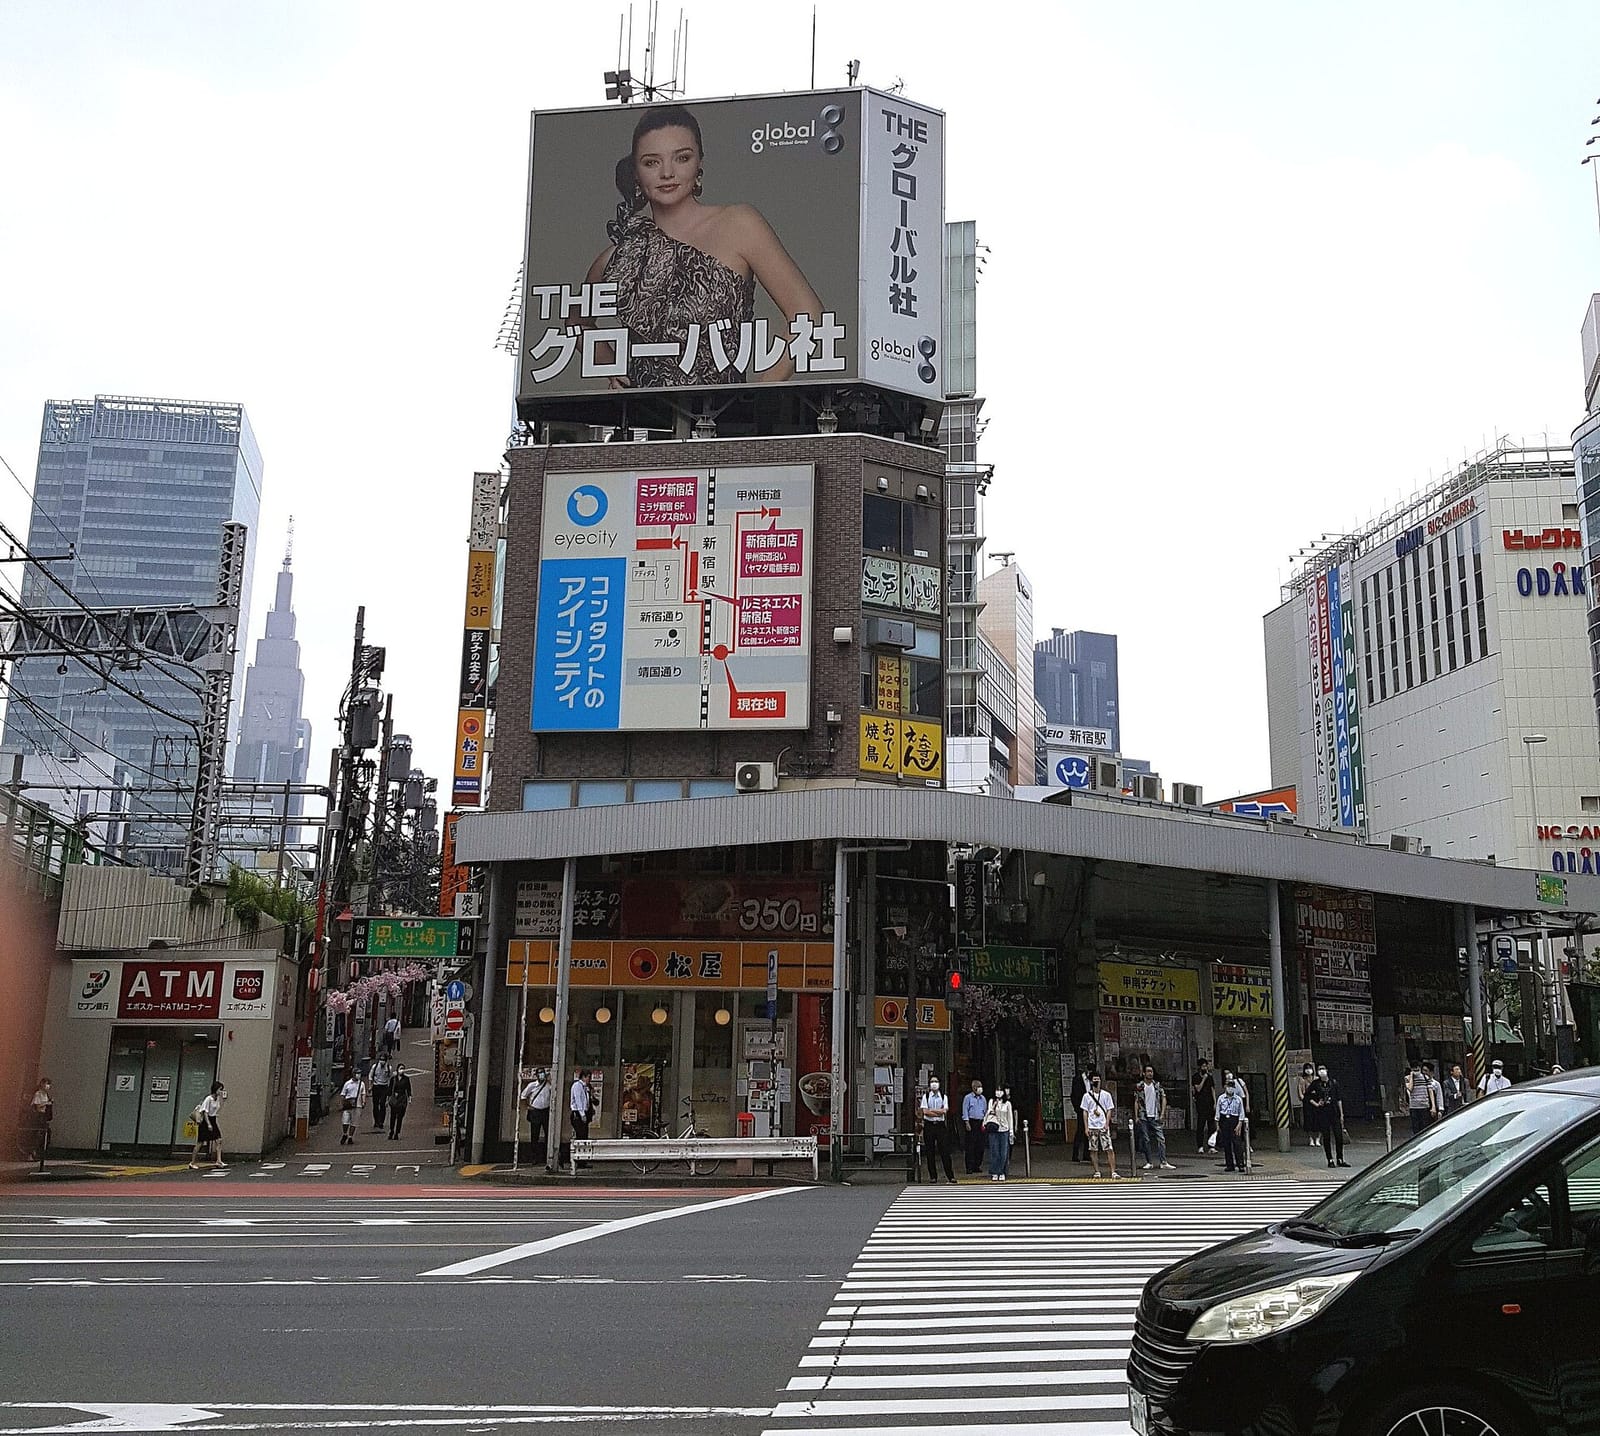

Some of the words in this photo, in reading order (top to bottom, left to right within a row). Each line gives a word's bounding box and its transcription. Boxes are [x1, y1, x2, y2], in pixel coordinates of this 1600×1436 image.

[751, 119, 816, 153] global
[881, 108, 929, 145] THE
[890, 143, 918, 319] グローバル社
[532, 282, 618, 320] THE
[529, 311, 847, 384] グローバル社
[871, 336, 915, 361] global
[640, 483, 695, 497] ミラザ新宿店
[736, 489, 781, 501] 甲州街道
[640, 502, 672, 511] ミラザ新宿
[674, 502, 685, 510] 6F
[1427, 516, 1441, 536] BIC
[1441, 496, 1476, 527] CAMERA
[555, 531, 618, 550] eyecity
[745, 533, 798, 548] 新宿南口店
[702, 536, 716, 589] 新宿駅
[470, 606, 488, 616] 3F
[742, 597, 800, 610] ルミネエスト
[640, 611, 684, 622] 新宿通り
[741, 611, 773, 624] 新宿店
[553, 576, 586, 709] アイシティ
[585, 576, 610, 709] コンタクトの
[654, 638, 680, 648] アルタ
[638, 666, 682, 678] 靖国通り
[737, 697, 777, 711] 現在地
[865, 723, 880, 764] 焼鳥
[883, 719, 895, 769] おでん
[1069, 729, 1106, 745] 新宿駅
[462, 737, 478, 769] 松屋
[1536, 825, 1562, 840] BIC
[739, 897, 817, 933] 350円
[664, 950, 723, 979] 松屋
[128, 970, 216, 998] ATM
[236, 977, 261, 987] EPOS
[127, 1002, 213, 1013] エポスカードATMコーナー
[226, 1003, 267, 1012] エポスカード
